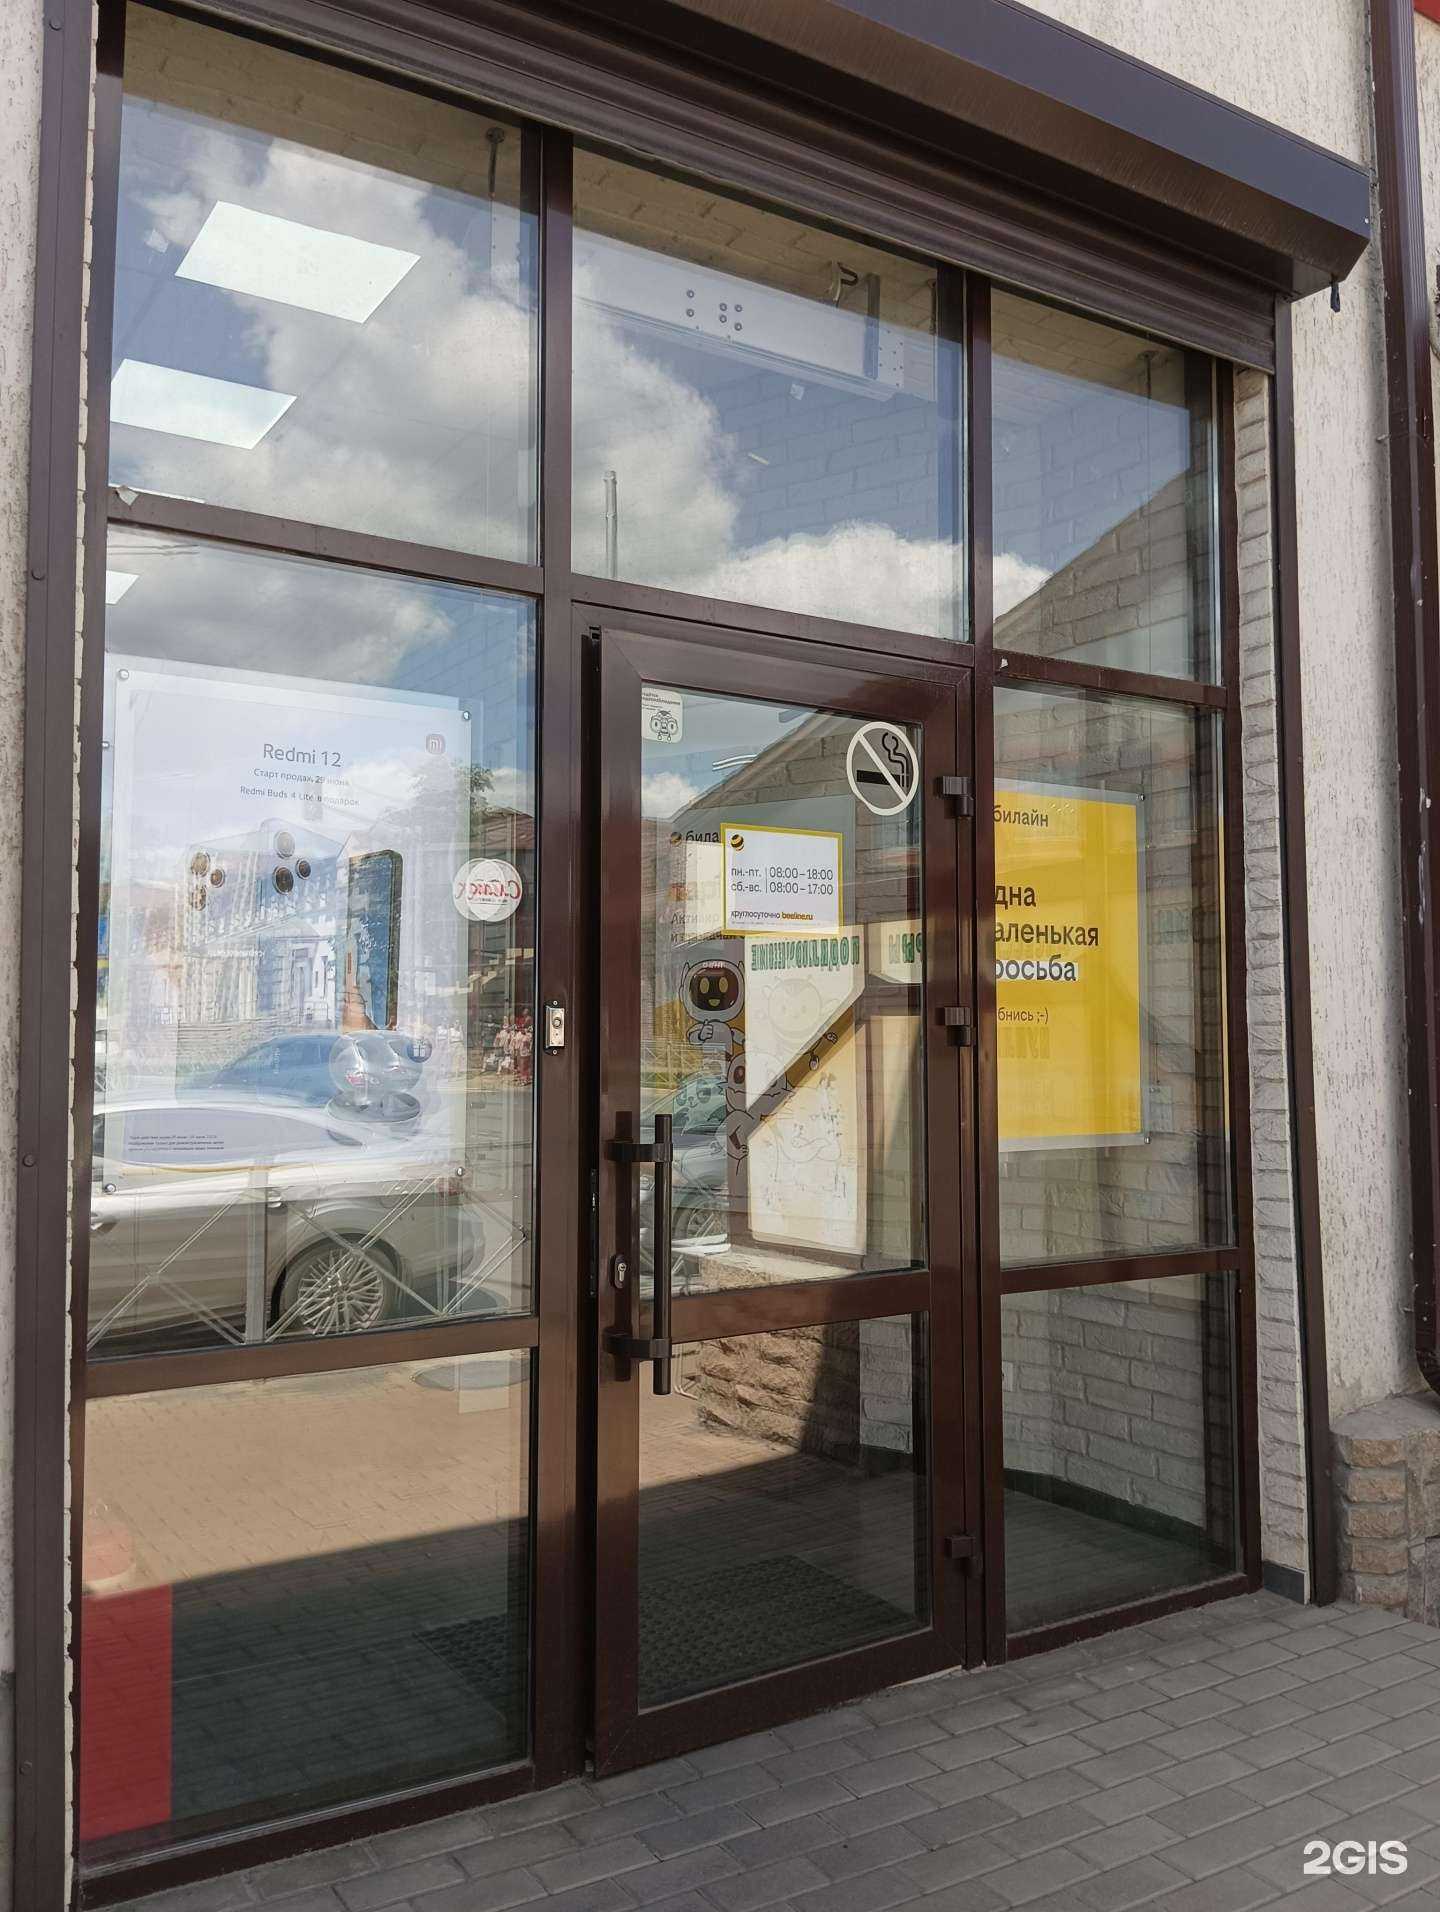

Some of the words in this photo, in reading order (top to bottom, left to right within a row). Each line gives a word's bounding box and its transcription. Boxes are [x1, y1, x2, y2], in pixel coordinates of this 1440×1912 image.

[263, 743, 316, 765] Redmi
[321, 750, 342, 768] 12
[253, 767, 278, 779] Старт
[240, 785, 265, 796] Redmi
[267, 788, 288, 799] Buds
[290, 791, 297, 800] 4
[993, 804, 1049, 827] билайн
[685, 831, 719, 844] била
[730, 866, 762, 879] пн.-пт.
[995, 885, 1037, 910] дна
[781, 911, 813, 921] beeline.ru
[995, 922, 1099, 946] аленькая
[995, 953, 1077, 982] росьба
[998, 1007, 1034, 1021] бнись
